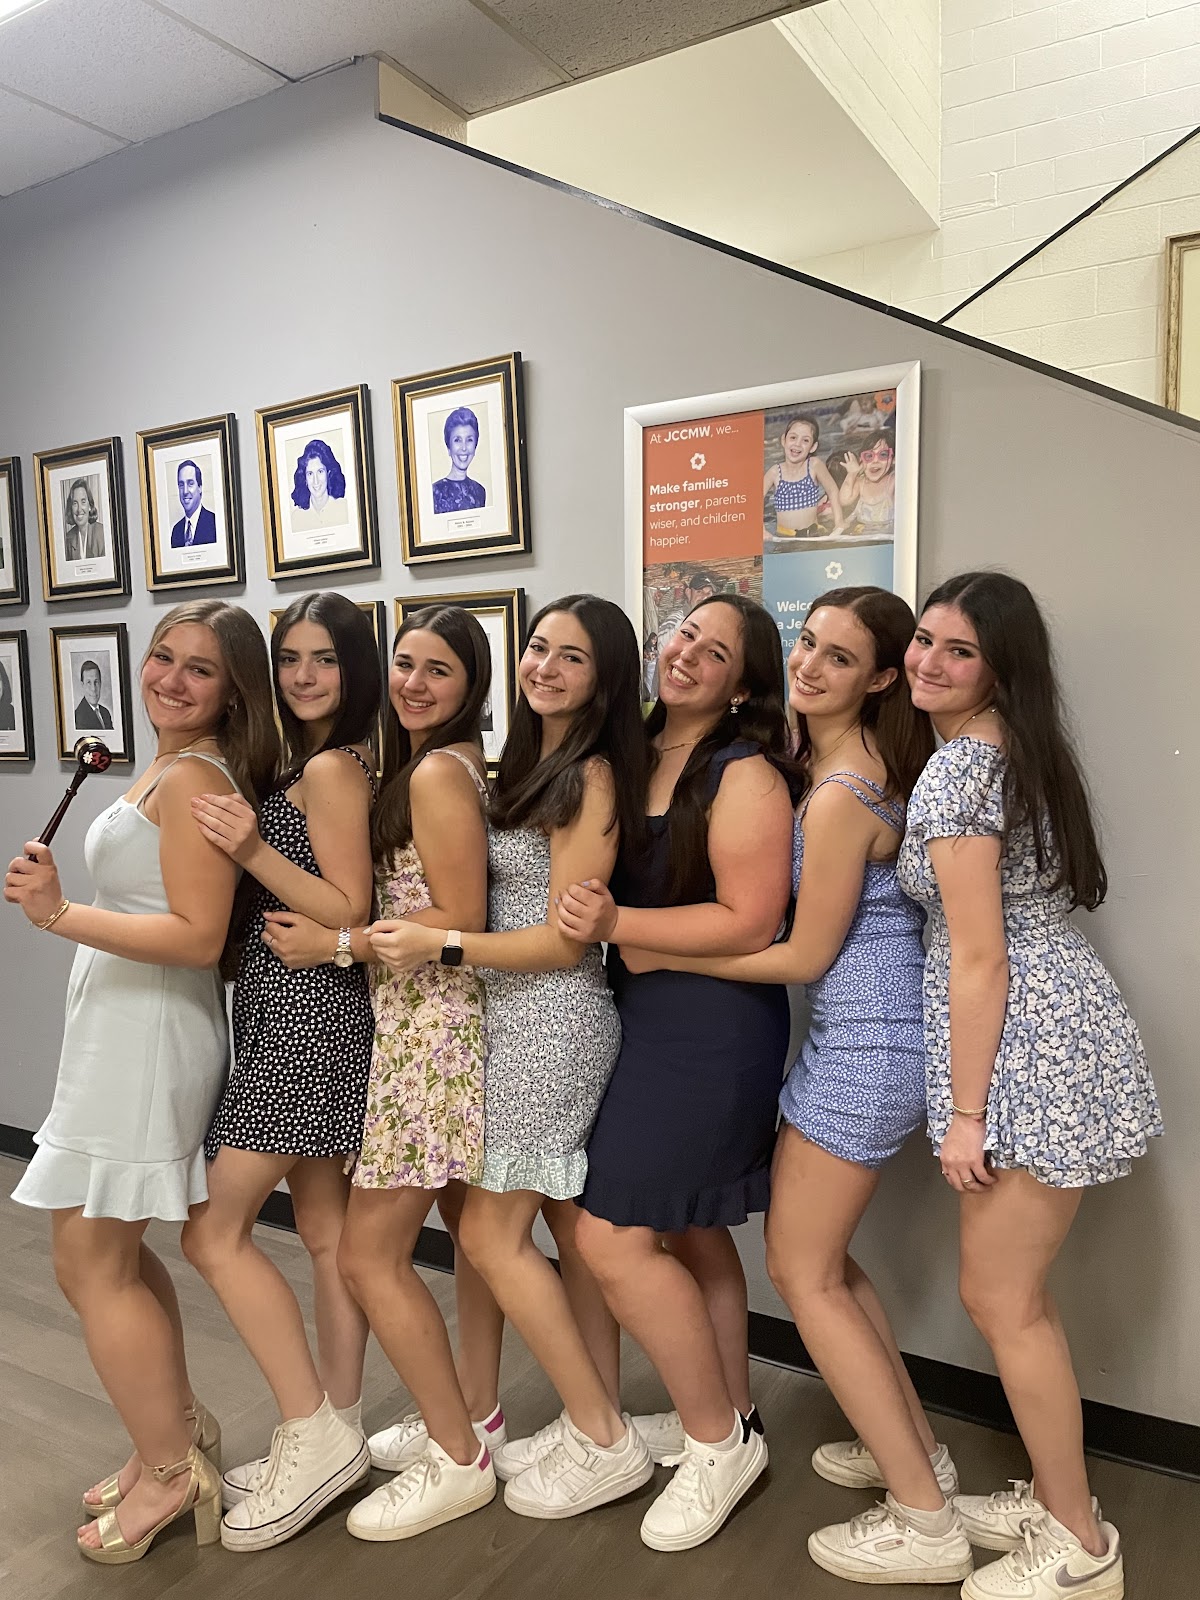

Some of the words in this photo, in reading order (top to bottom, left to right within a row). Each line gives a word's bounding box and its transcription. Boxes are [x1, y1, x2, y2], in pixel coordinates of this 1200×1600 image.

[649, 433, 661, 444] At
[664, 425, 713, 442] JCCMW,
[649, 483, 680, 495] Make
[682, 477, 729, 492] families
[649, 499, 703, 512] stronger,
[705, 493, 747, 509] parents
[650, 519, 678, 530] wiser,
[680, 515, 700, 527] and
[702, 511, 746, 525] children
[649, 534, 691, 548] happier.
